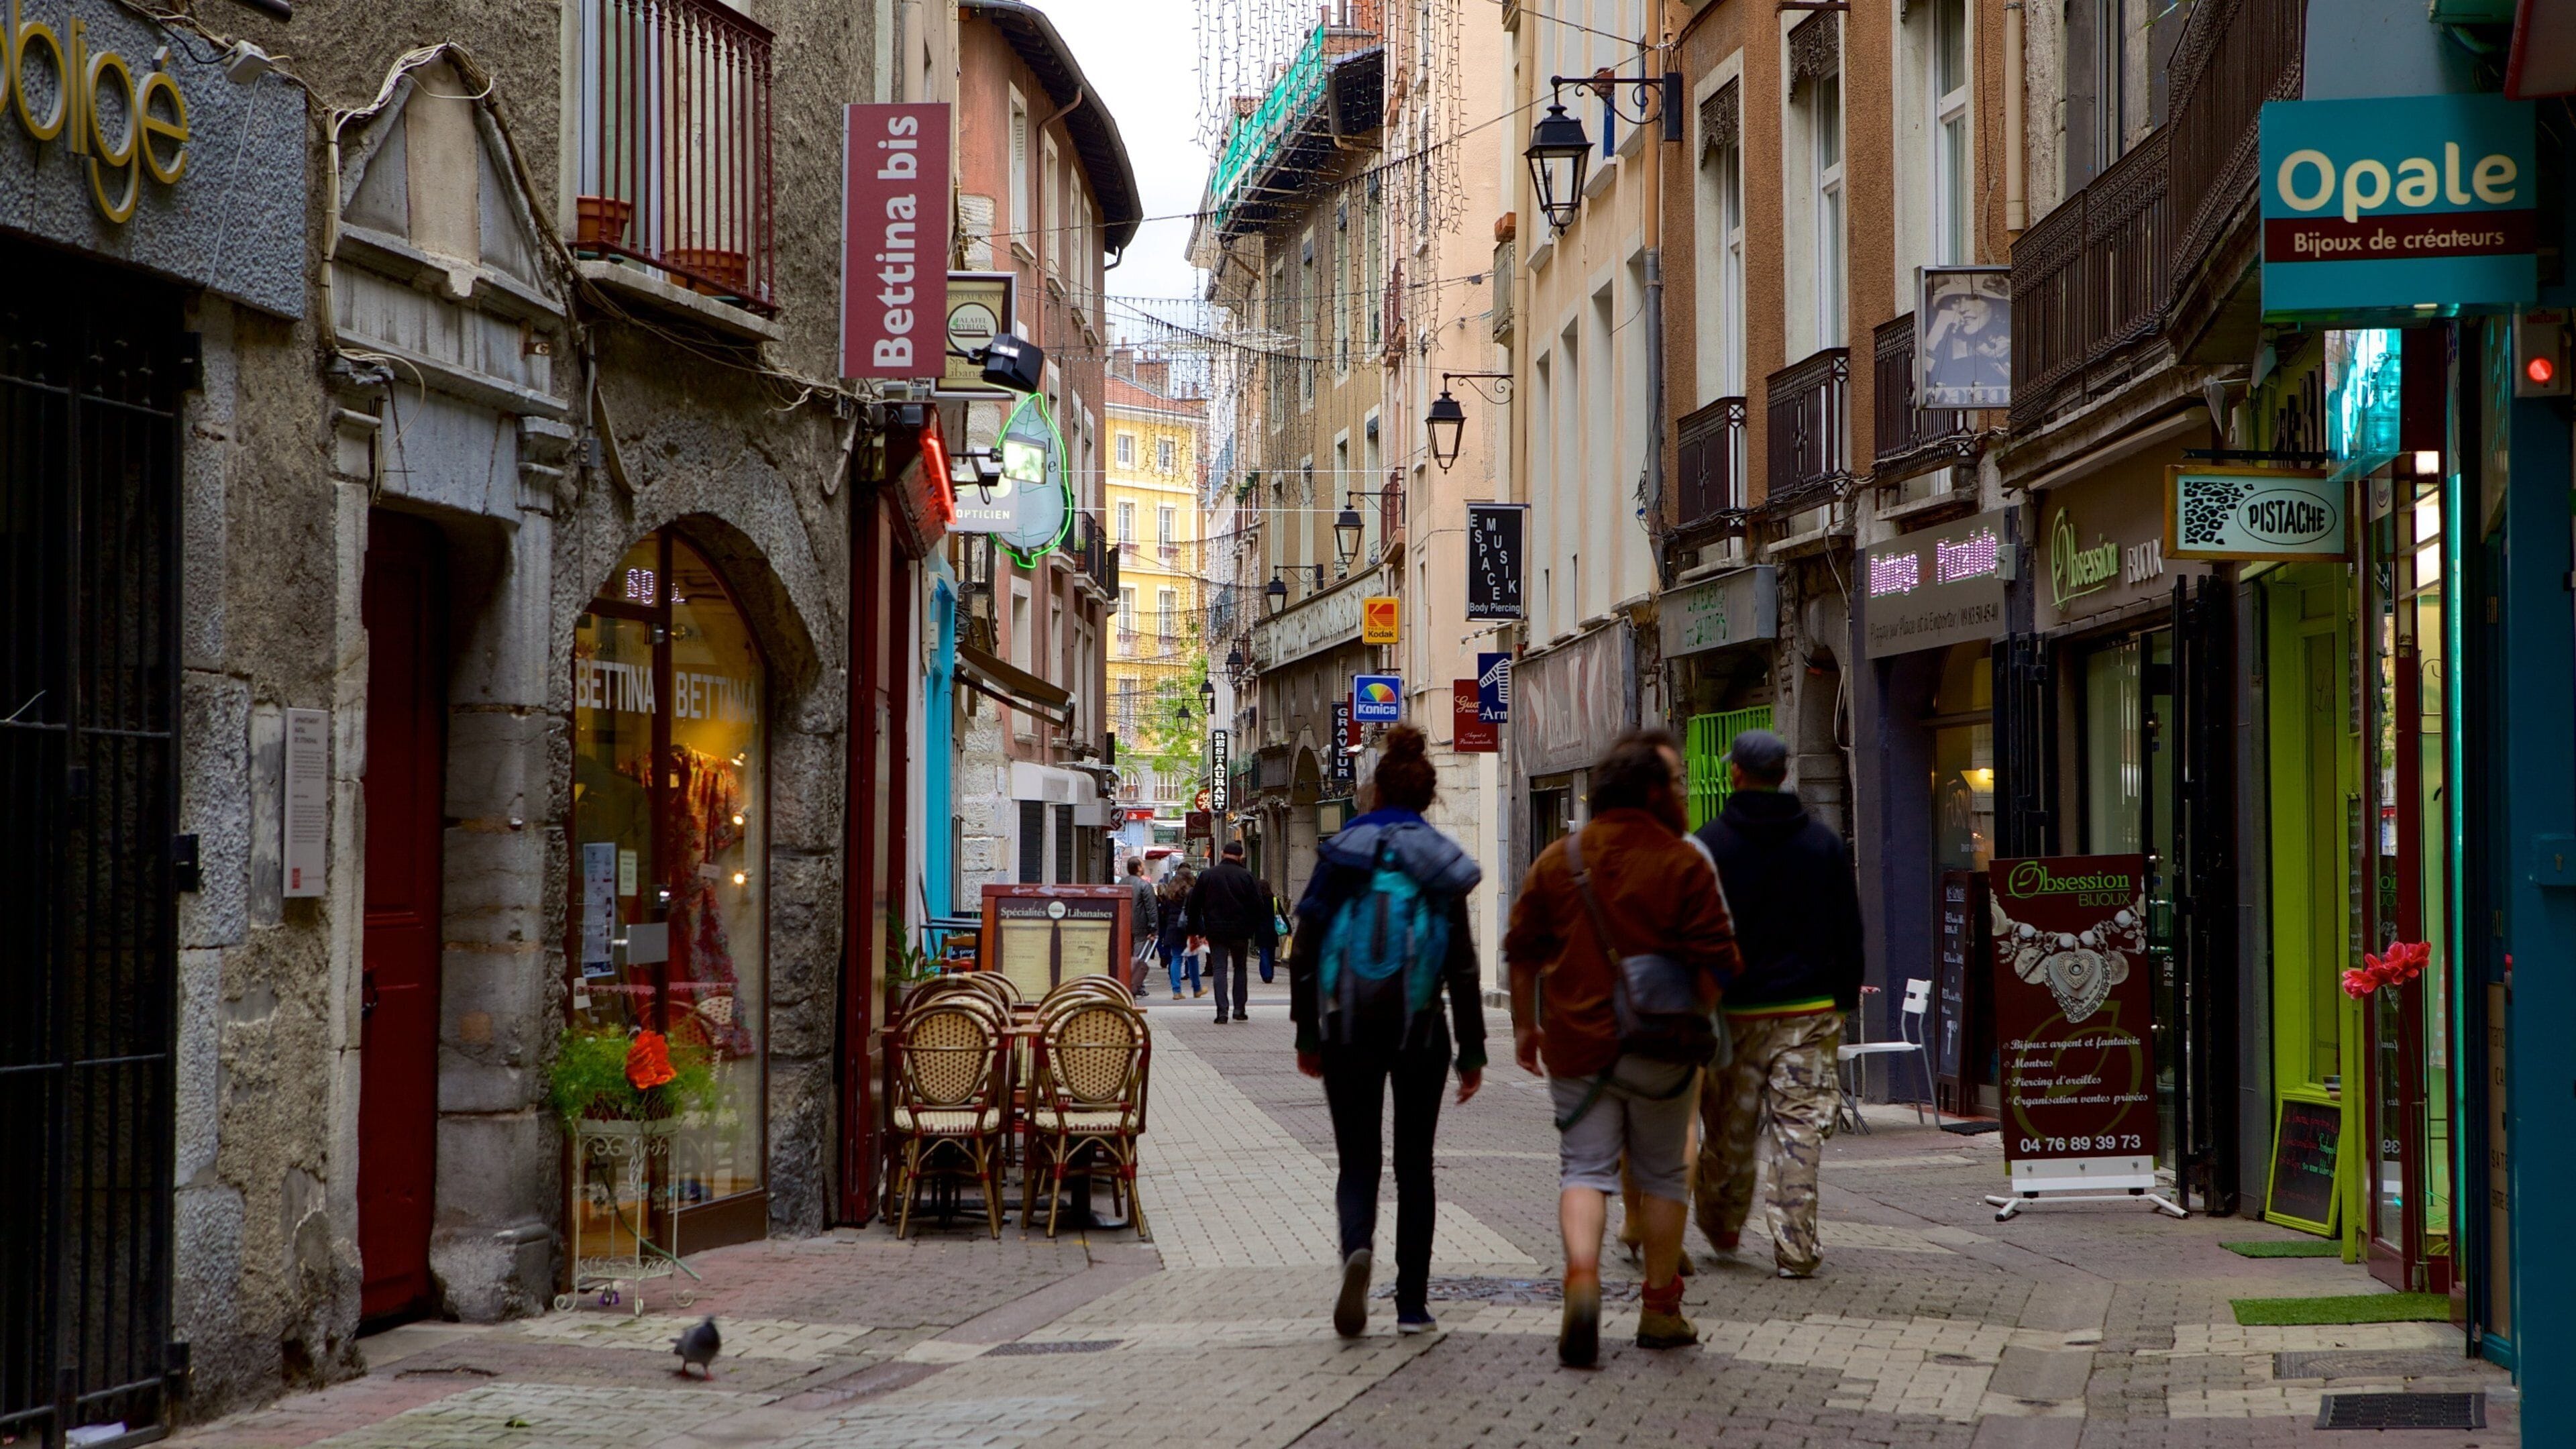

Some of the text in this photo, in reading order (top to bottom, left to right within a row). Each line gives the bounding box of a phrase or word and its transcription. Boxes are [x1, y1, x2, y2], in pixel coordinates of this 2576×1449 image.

[0, 0, 189, 224] bligé
[2277, 142, 2518, 223] Opale
[873, 115, 918, 367] Bettina bis
[2294, 228, 2506, 258] Bijoux de créateurs
[2526, 313, 2561, 323] NEON
[956, 508, 1010, 521] OPTICIEN
[2249, 500, 2325, 534] PISTACHE
[1470, 514, 1501, 600] ESPACE
[1486, 517, 1517, 594] MUSIK
[1870, 551, 1919, 598] Bottega
[1937, 526, 1997, 586] Pizzaiolo
[2051, 506, 2163, 609] Obsession BIJOUX
[1470, 602, 1521, 614] Body Piercing
[576, 658, 656, 714] BETTINA
[676, 672, 758, 724] BETTINA
[1358, 704, 1397, 714] Konica
[1337, 707, 1348, 777] GRAVEUR
[1214, 732, 1226, 809] RESTAURANT
[2008, 860, 2131, 898] Obsession
[1000, 907, 1113, 918] Spécialités Libanaises
[2078, 892, 2131, 907] BIJOUX
[2010, 1036, 2141, 1052] Bijoux argent et fantaisie
[2010, 1058, 2053, 1069] Montres
[2012, 1074, 2102, 1087] Piercing d'oreilles
[2012, 1091, 2149, 1108] Organisation ventes privées
[2020, 1134, 2142, 1152] 04 76 89 39 73
